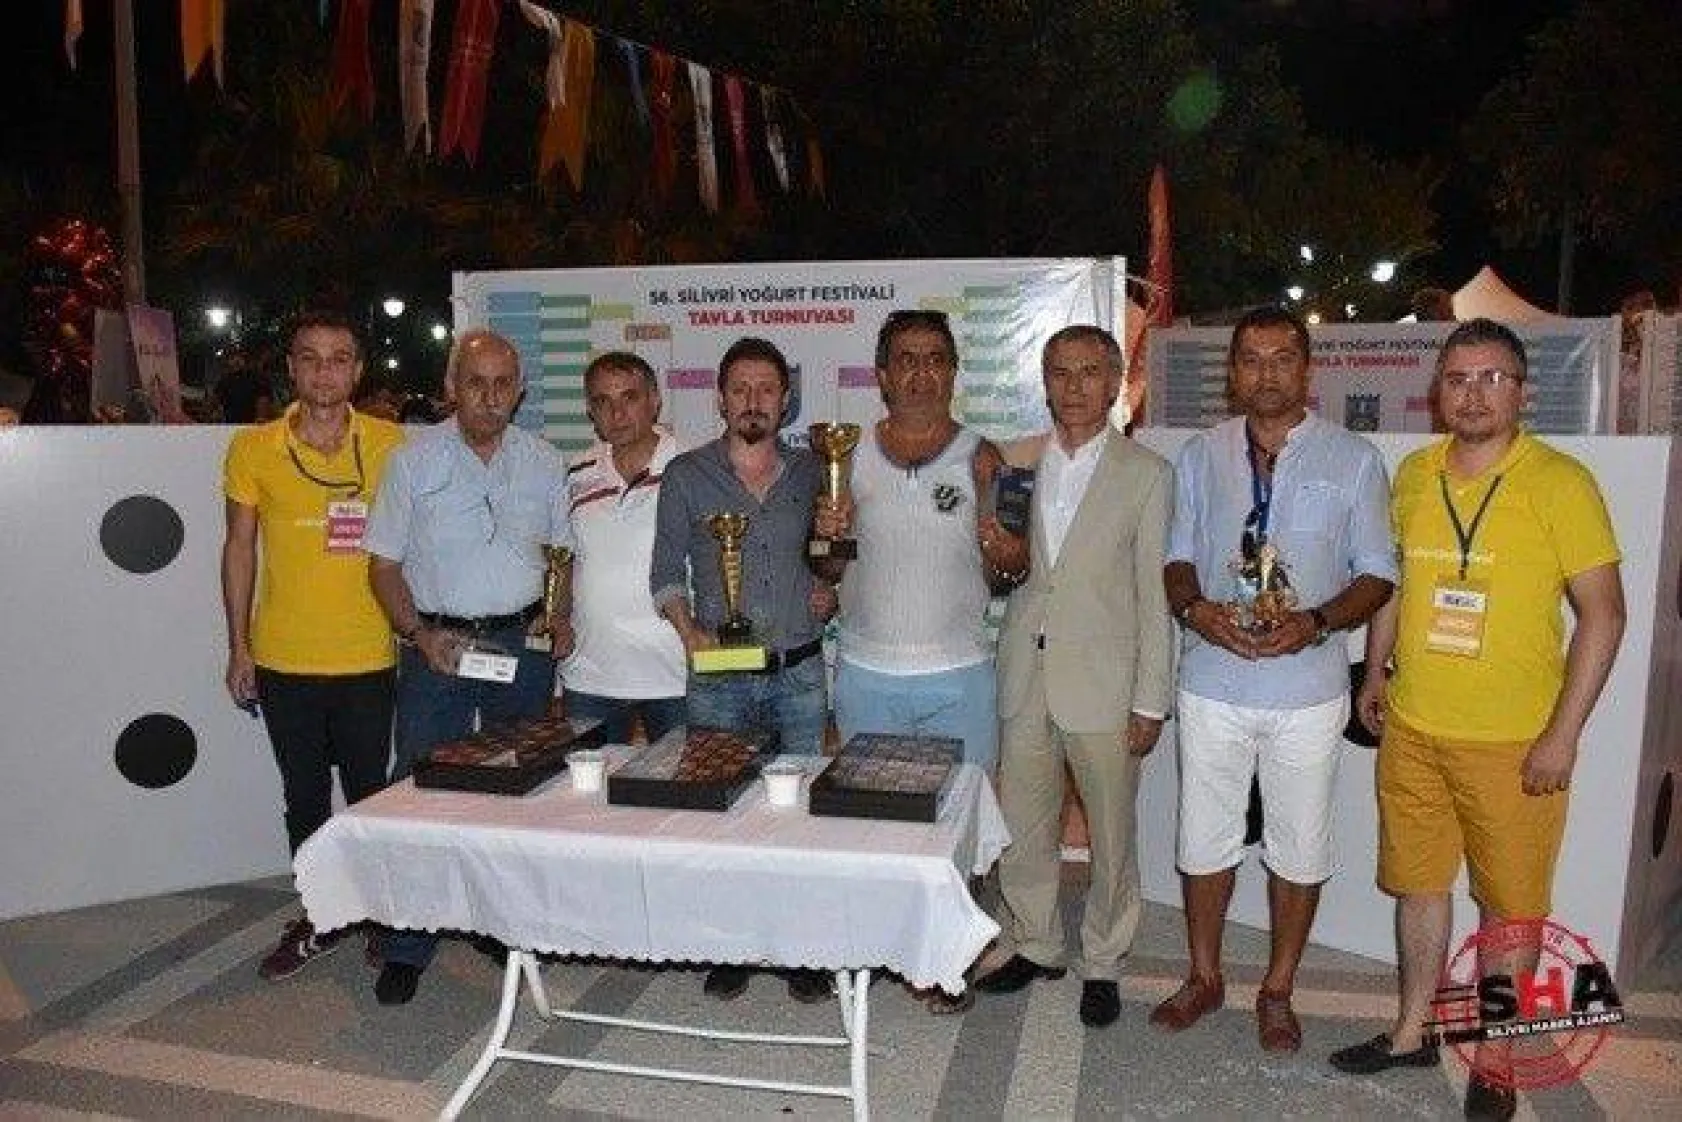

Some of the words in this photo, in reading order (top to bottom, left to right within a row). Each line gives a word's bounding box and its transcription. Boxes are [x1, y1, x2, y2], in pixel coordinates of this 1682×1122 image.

[648, 288, 674, 305] 56.
[678, 285, 734, 303] SİLİVRİ
[738, 286, 806, 302] YOĞURT
[811, 283, 894, 300] FESTİVALİ
[688, 309, 745, 326] TAVLA
[750, 308, 855, 325] TURNUVASI
